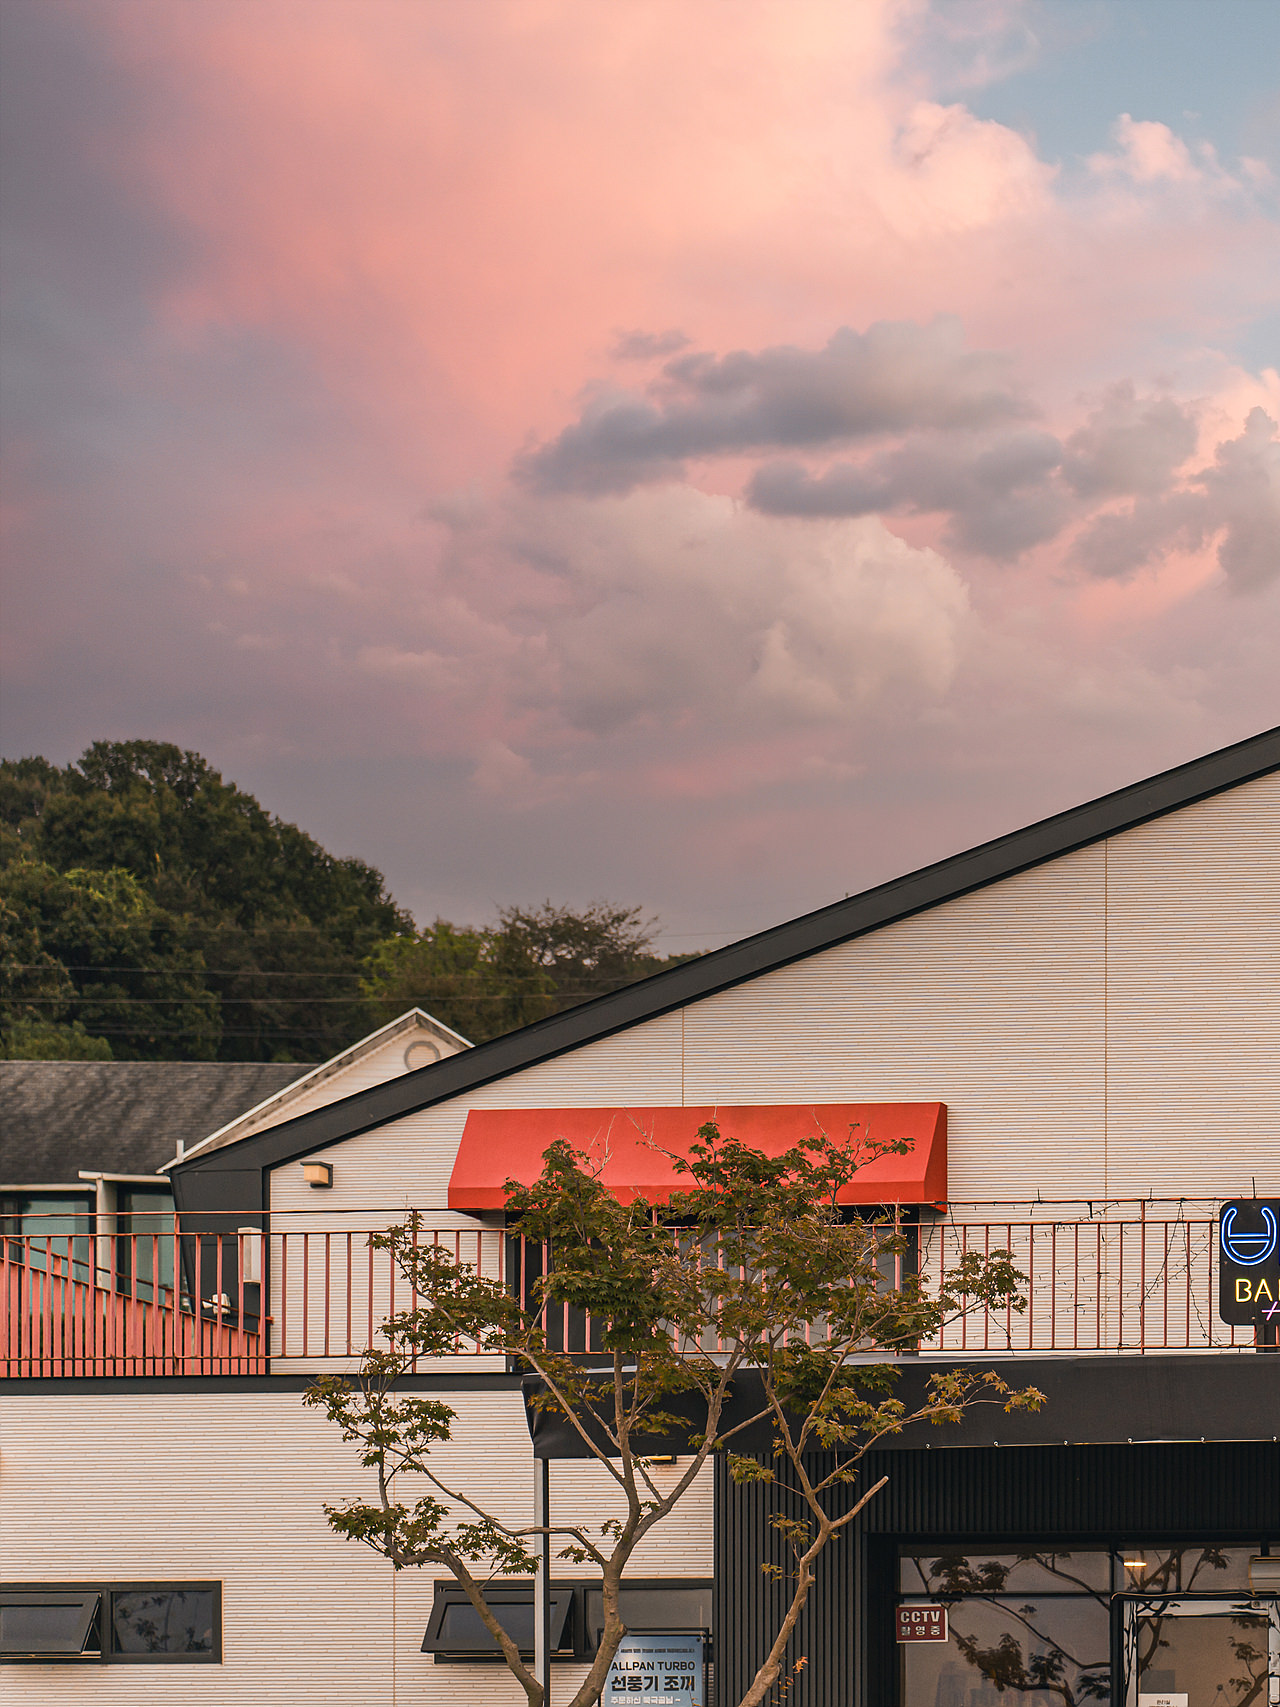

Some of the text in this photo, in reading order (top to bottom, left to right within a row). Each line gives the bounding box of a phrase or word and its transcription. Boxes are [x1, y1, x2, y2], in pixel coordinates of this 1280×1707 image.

[900, 1611, 941, 1623] CCTV
[611, 1661, 696, 1671] ALLPAN TURBO
[611, 1675, 695, 1691] 선풍기 조끼
